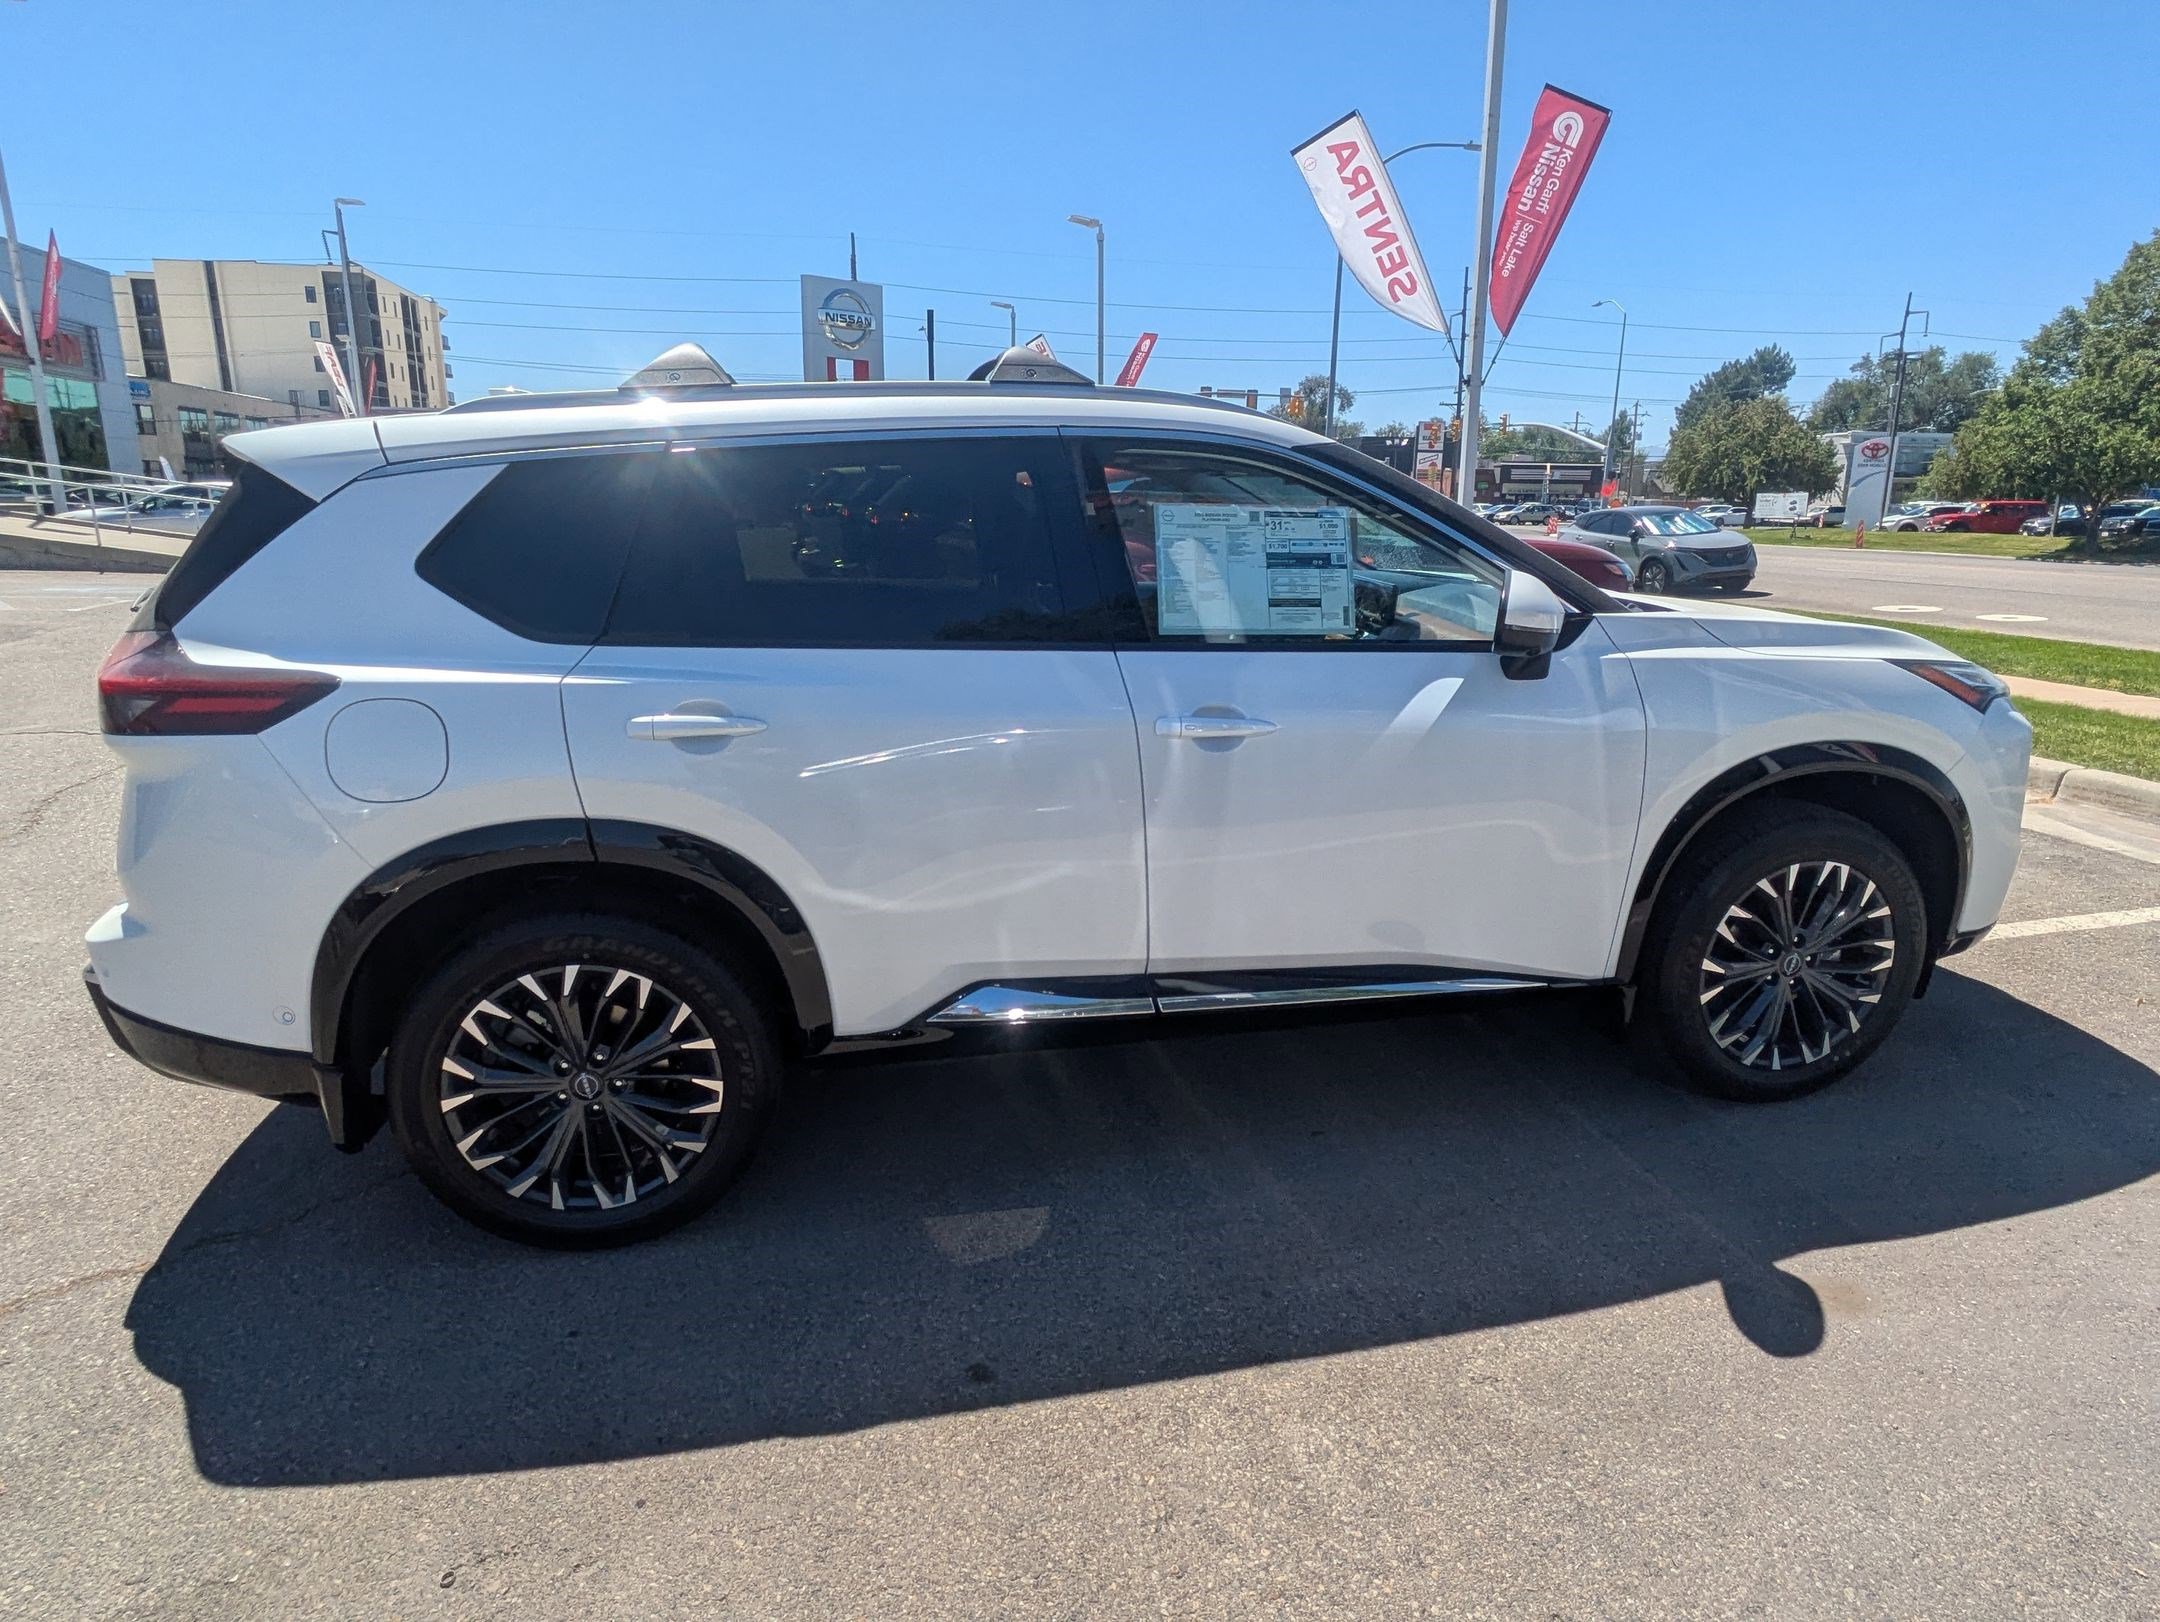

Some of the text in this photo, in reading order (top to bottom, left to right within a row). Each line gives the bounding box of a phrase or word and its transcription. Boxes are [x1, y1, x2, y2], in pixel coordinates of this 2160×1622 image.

[1517, 142, 1561, 212] Nissan
[1535, 147, 1574, 215] Ken Garff
[1512, 219, 1523, 232] we
[1501, 222, 1534, 278] Salt Lake
[825, 311, 872, 328] NISSAN
[1270, 520, 1283, 531] 31
